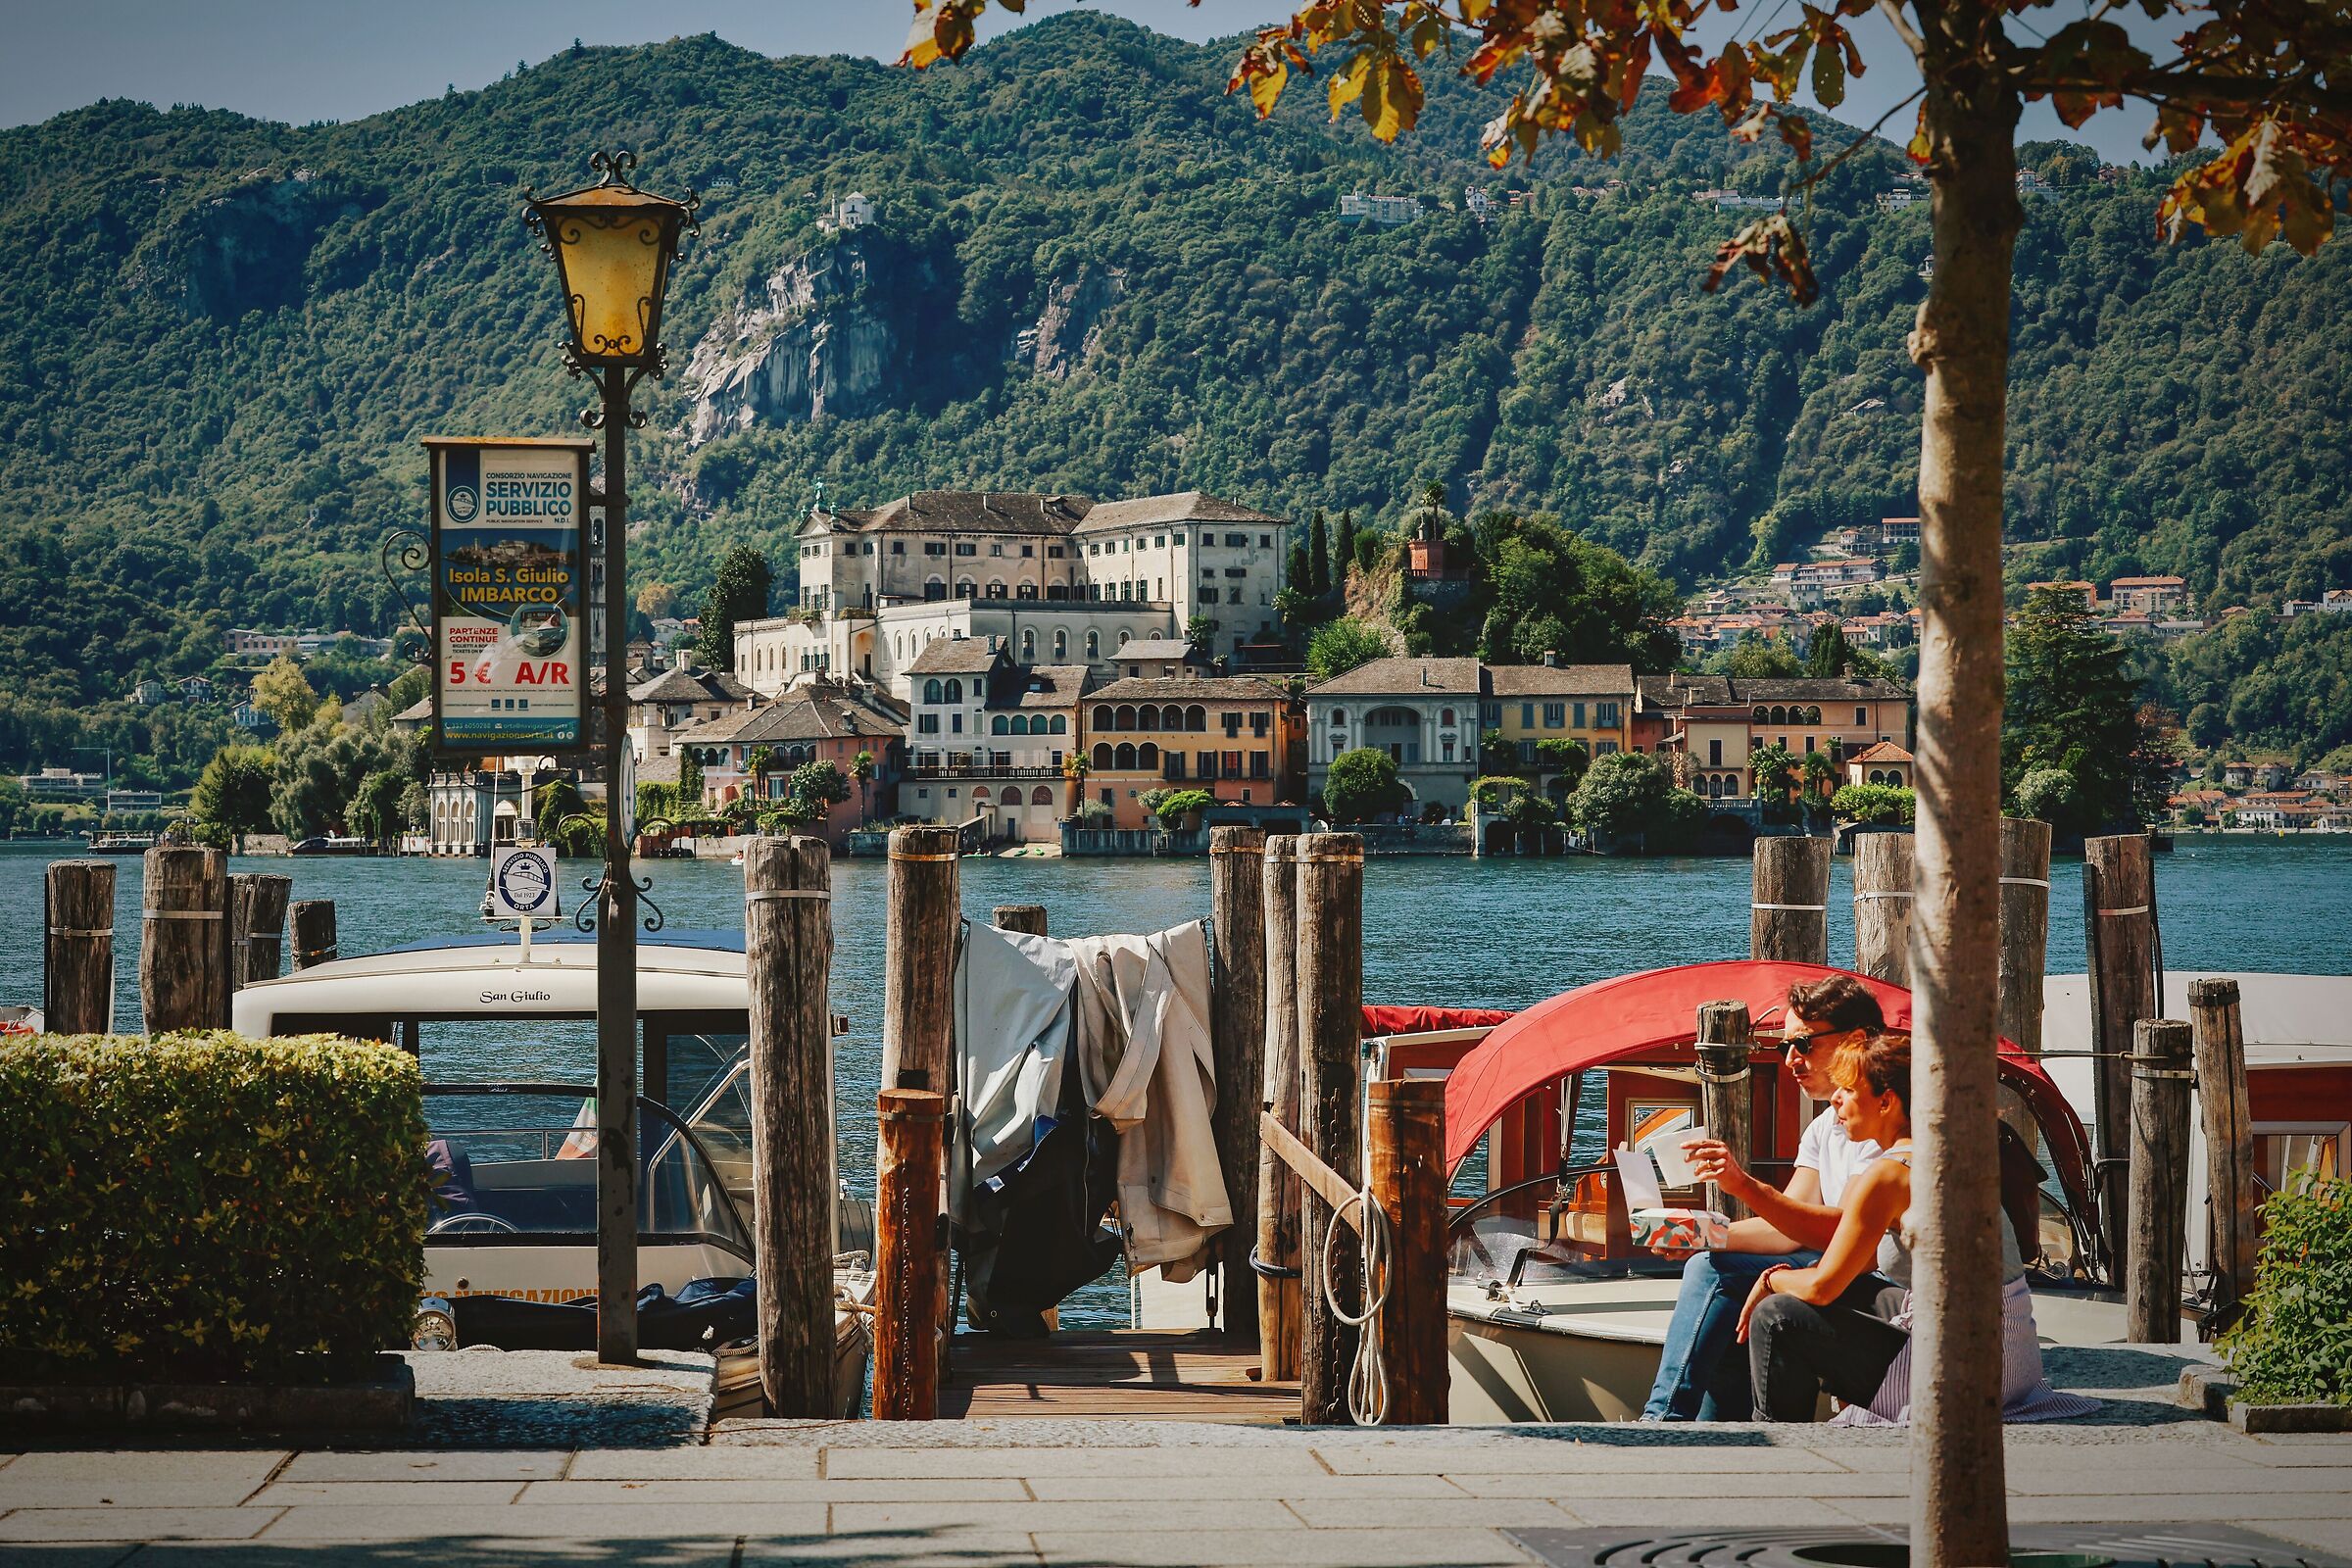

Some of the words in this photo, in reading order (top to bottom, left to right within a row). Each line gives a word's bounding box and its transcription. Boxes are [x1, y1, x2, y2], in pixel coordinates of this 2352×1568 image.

[485, 481, 572, 498] SERVIZIO
[485, 500, 572, 515] PUBBLICO
[449, 567, 490, 583] Isola
[495, 567, 511, 583] S.
[515, 567, 568, 583] Giulio
[461, 587, 558, 603] IMBARCO
[450, 662, 466, 684] 5
[514, 662, 569, 685] A/R
[502, 853, 524, 873] SERVIZIO
[525, 853, 549, 873] PUBBLICO
[479, 991, 507, 1004] San
[511, 990, 551, 1003] Giulio
